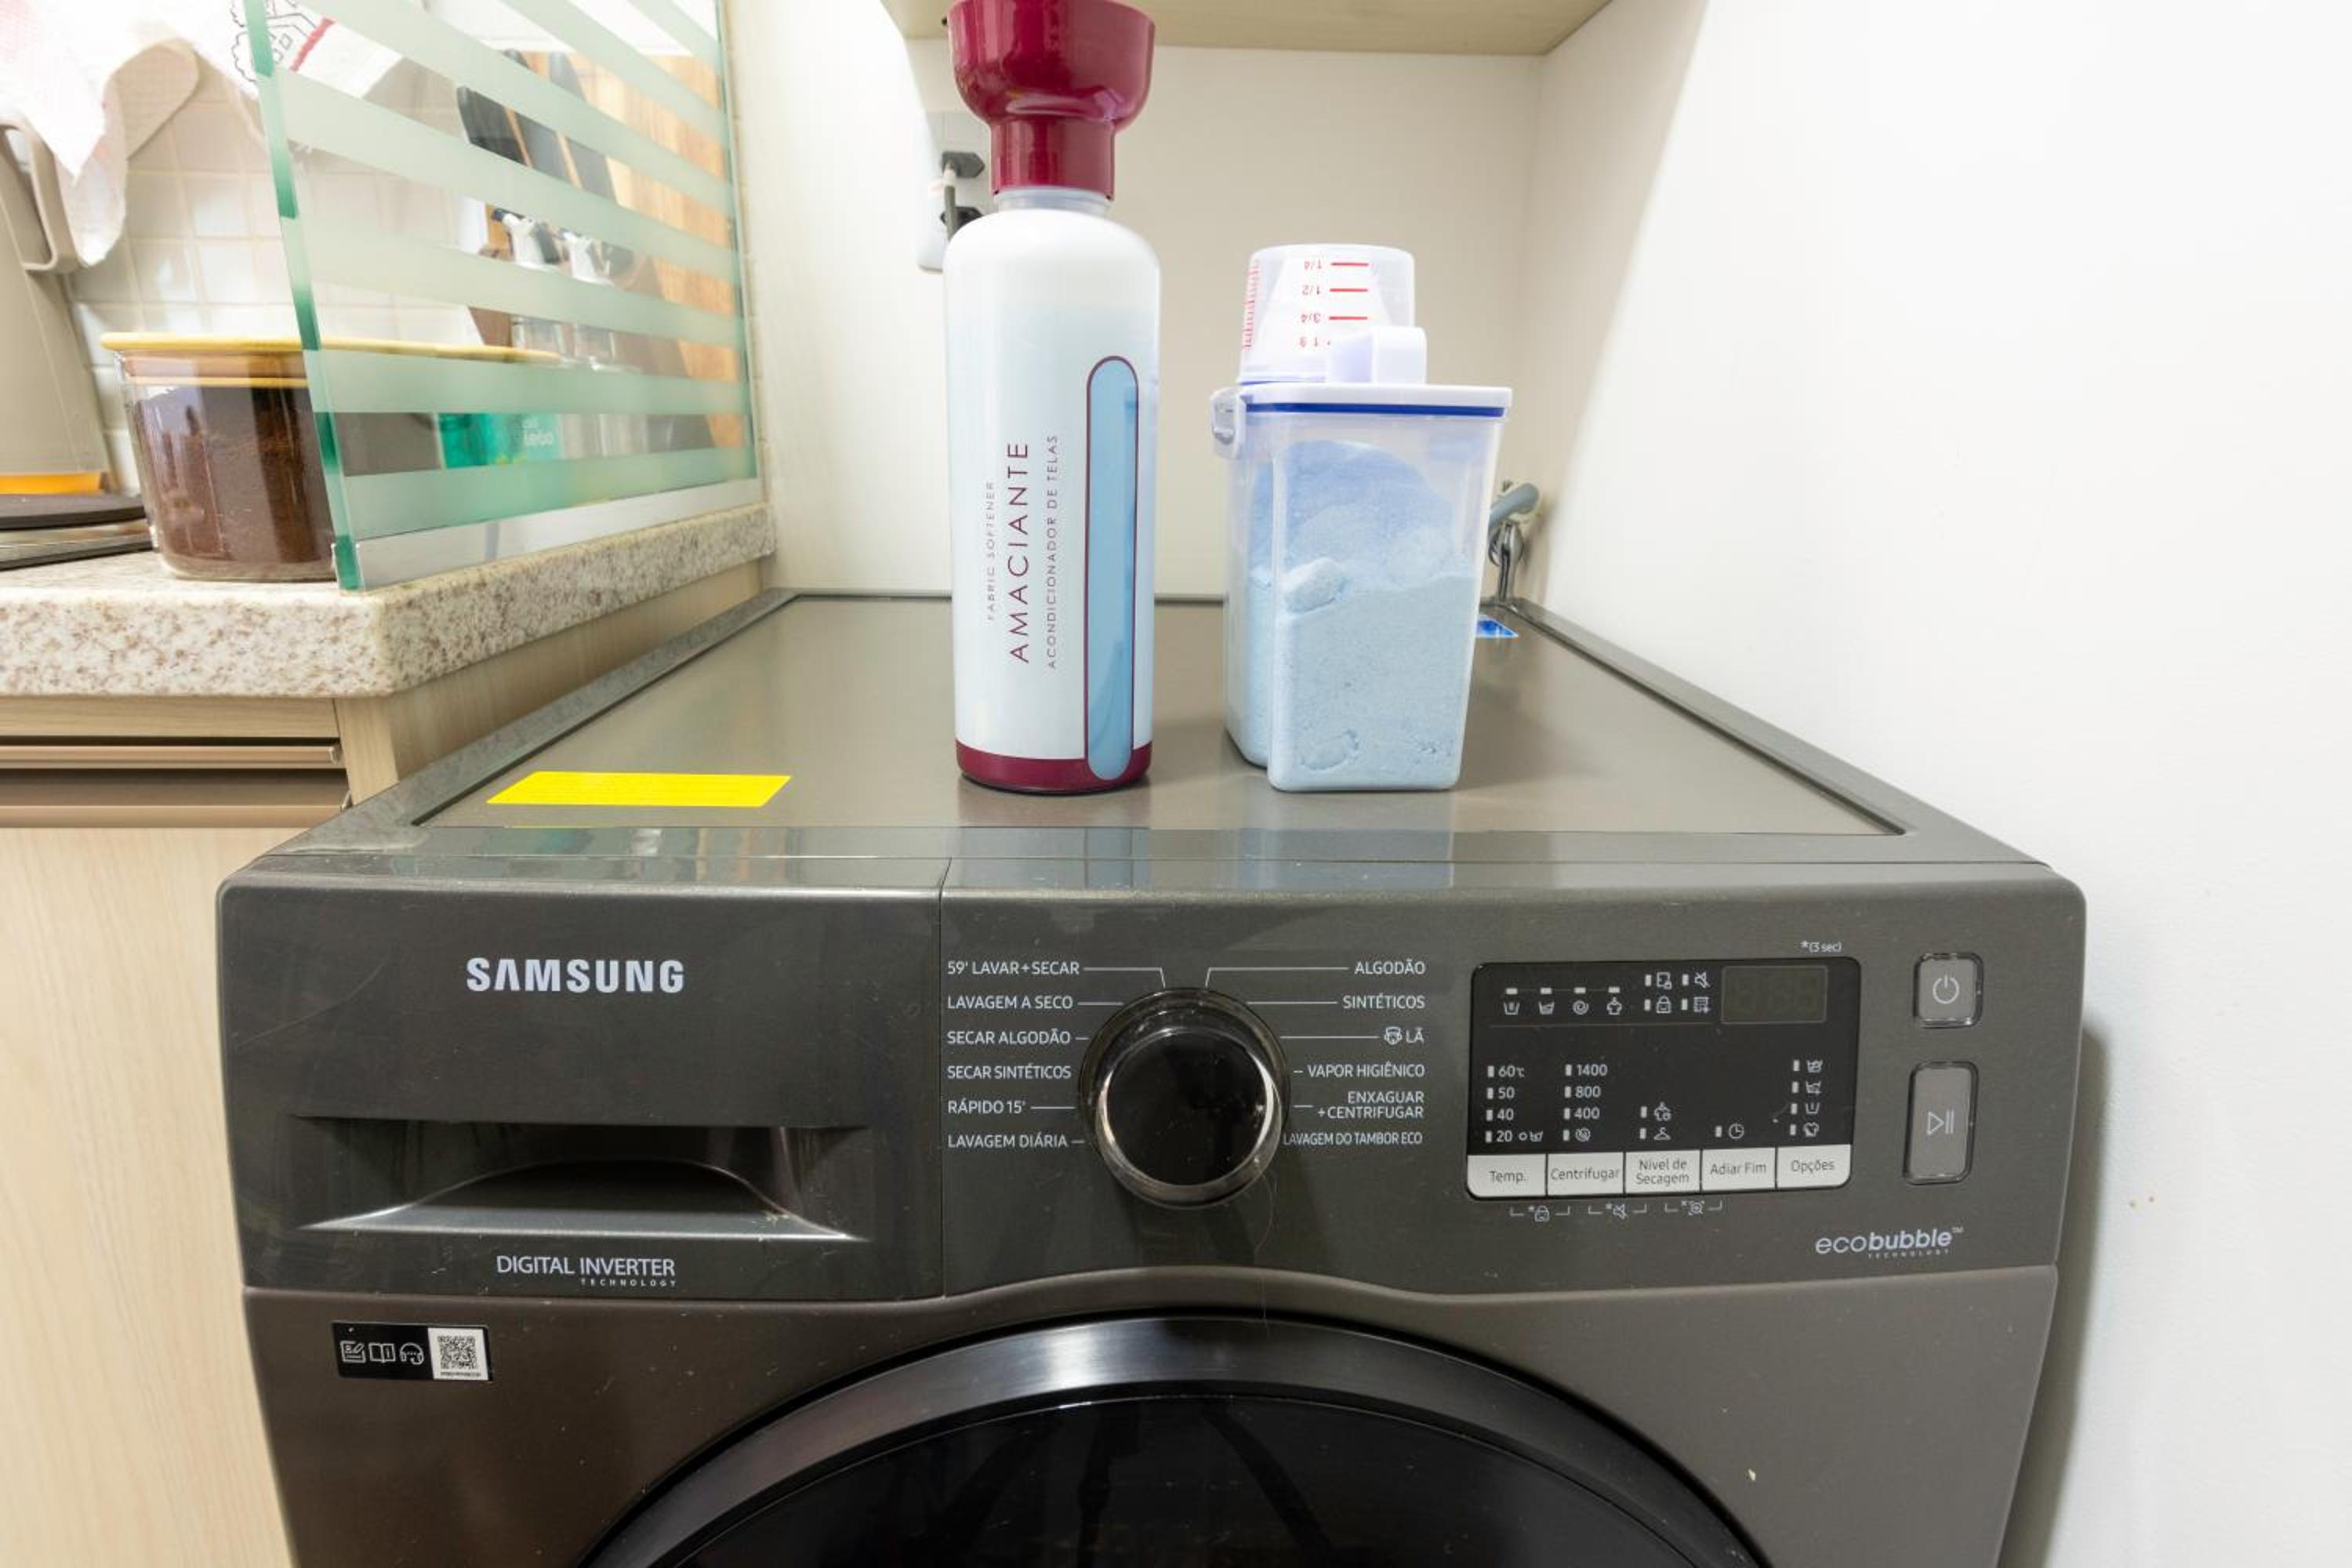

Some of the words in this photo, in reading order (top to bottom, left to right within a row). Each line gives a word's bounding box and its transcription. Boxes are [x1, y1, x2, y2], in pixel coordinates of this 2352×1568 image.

[1301, 285, 1321, 296] 1/2
[1301, 313, 1321, 323] 3/4
[1047, 435, 1058, 482] TELAS
[1047, 489, 1057, 508] DE
[985, 481, 995, 557] SOFTENER
[1007, 444, 1029, 664] AMACIANTE
[985, 567, 995, 621] FABRIC
[1047, 517, 1056, 669] ACONDICIONADOR
[947, 961, 968, 975] 59'
[1355, 959, 1426, 975] ALGODÃO
[466, 957, 684, 993] SAMSUNG
[948, 996, 1018, 1010] LAVAGEM
[1021, 996, 1031, 1009] A
[1034, 996, 1073, 1010] SECO
[1343, 993, 1425, 1010] SINTÉTICOS
[946, 1030, 995, 1045] SECAR
[999, 1028, 1071, 1045] ALGODÃO
[1406, 1026, 1425, 1044] LÃ
[947, 1065, 992, 1080] SECAR
[995, 1062, 1072, 1080] SINTÉTICOS
[1308, 1064, 1354, 1078] VAPOR
[1357, 1061, 1425, 1078] HIGIÊNICO
[1577, 1064, 1608, 1076] 1400
[1348, 1091, 1425, 1103] ENXAGUAR
[1497, 1087, 1515, 1099] 50
[1575, 1086, 1601, 1098] 800
[948, 1097, 1004, 1113] RÁPIDO
[1317, 1106, 1425, 1119] +CENTRIFUGAR
[1497, 1109, 1515, 1121] 40
[1573, 1107, 1600, 1120] 400
[948, 1135, 1015, 1149] LAVAGEM
[1020, 1131, 1068, 1148] DIÁRIA
[1283, 1132, 1333, 1145] LAVAGEM
[1335, 1132, 1352, 1145] DO
[1354, 1131, 1399, 1145] TAMBOR
[1401, 1131, 1423, 1145] ECO
[1497, 1131, 1512, 1142] 20
[1673, 1159, 1687, 1170] de
[1710, 1163, 1741, 1175] Adiar
[1745, 1163, 1766, 1174] Fim
[1791, 1160, 1835, 1174] Opções
[1490, 1171, 1527, 1183] Temp.
[1551, 1168, 1621, 1181] Centrifugar
[1636, 1173, 1690, 1187] Secagem
[496, 1255, 574, 1275] DIGITAL
[580, 1258, 676, 1276] INVERTER
[581, 1279, 677, 1287] TECHNOLOGY
